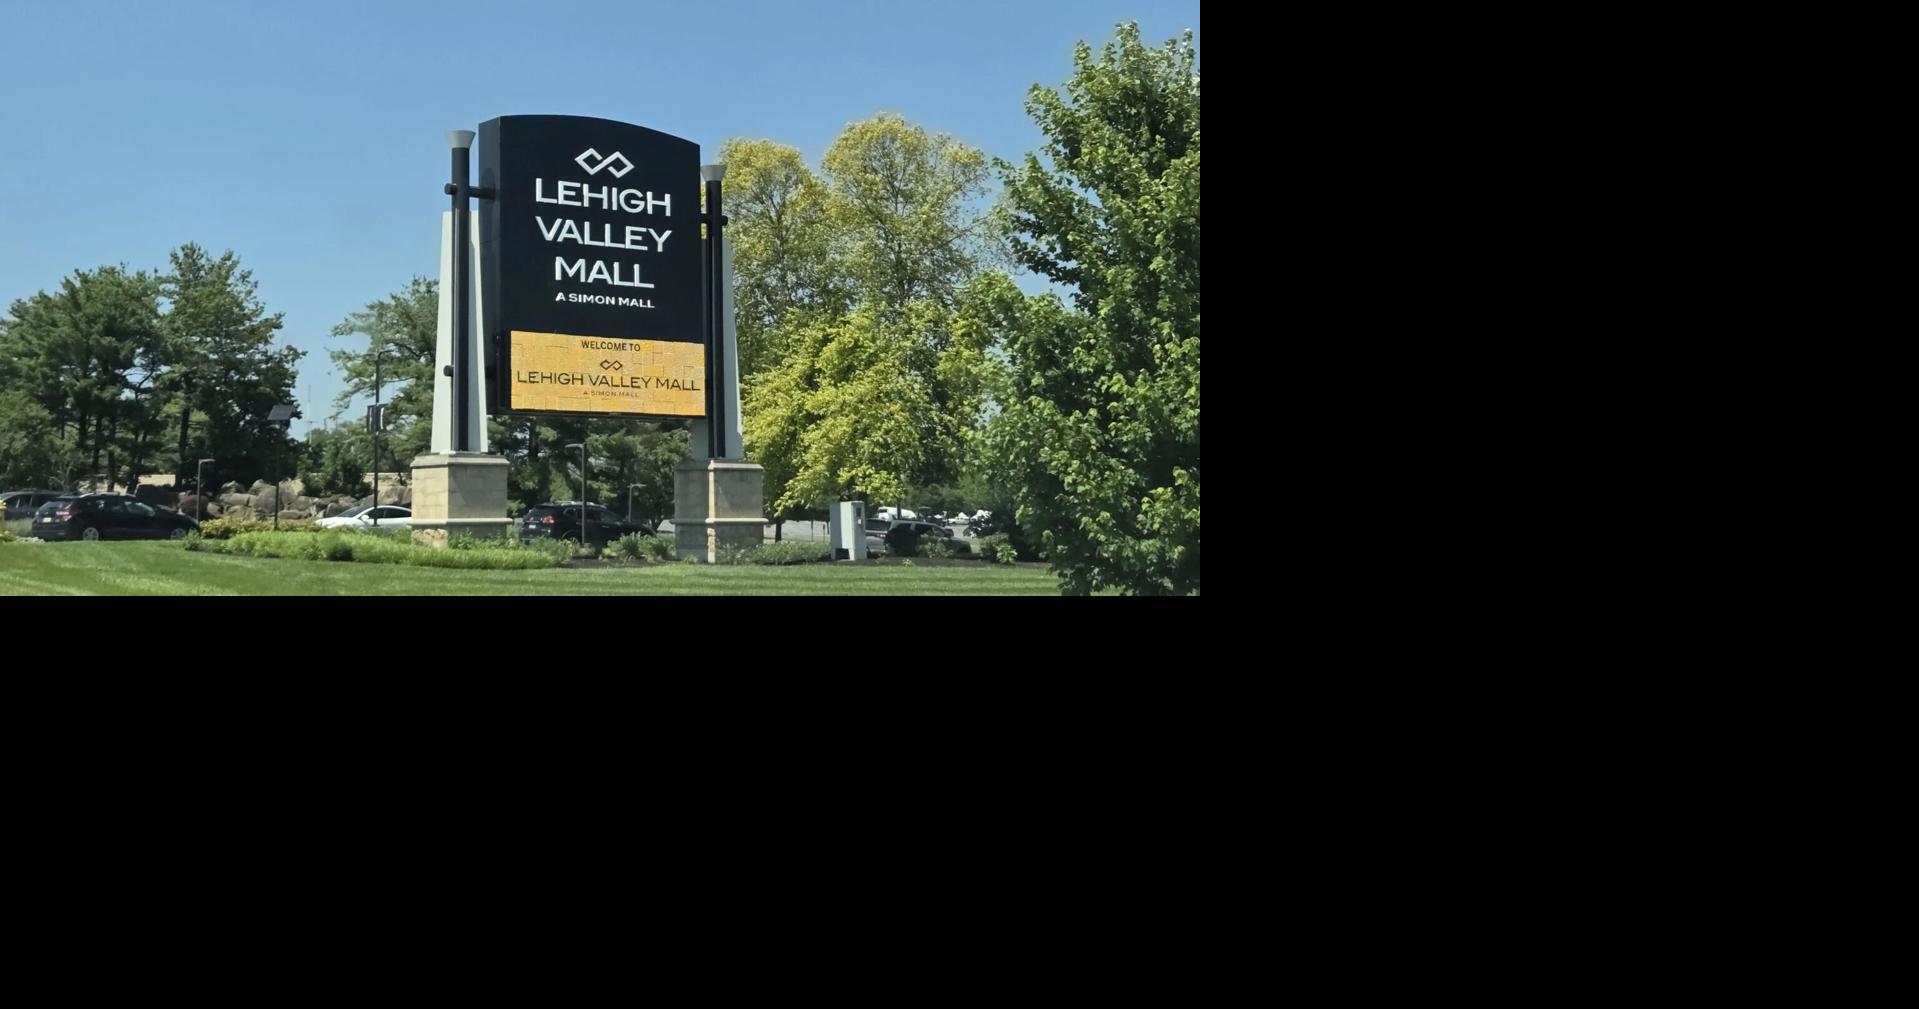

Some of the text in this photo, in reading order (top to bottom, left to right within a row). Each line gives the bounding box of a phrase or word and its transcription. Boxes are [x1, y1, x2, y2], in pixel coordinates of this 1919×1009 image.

[535, 177, 671, 217] LEHIGH
[535, 216, 672, 253] VALLEY
[554, 256, 655, 289] MALL
[555, 292, 655, 308] A SIMON MALL
[581, 340, 641, 352] WELCOME TO
[517, 370, 701, 391] LEHIGH VALLEY MALL
